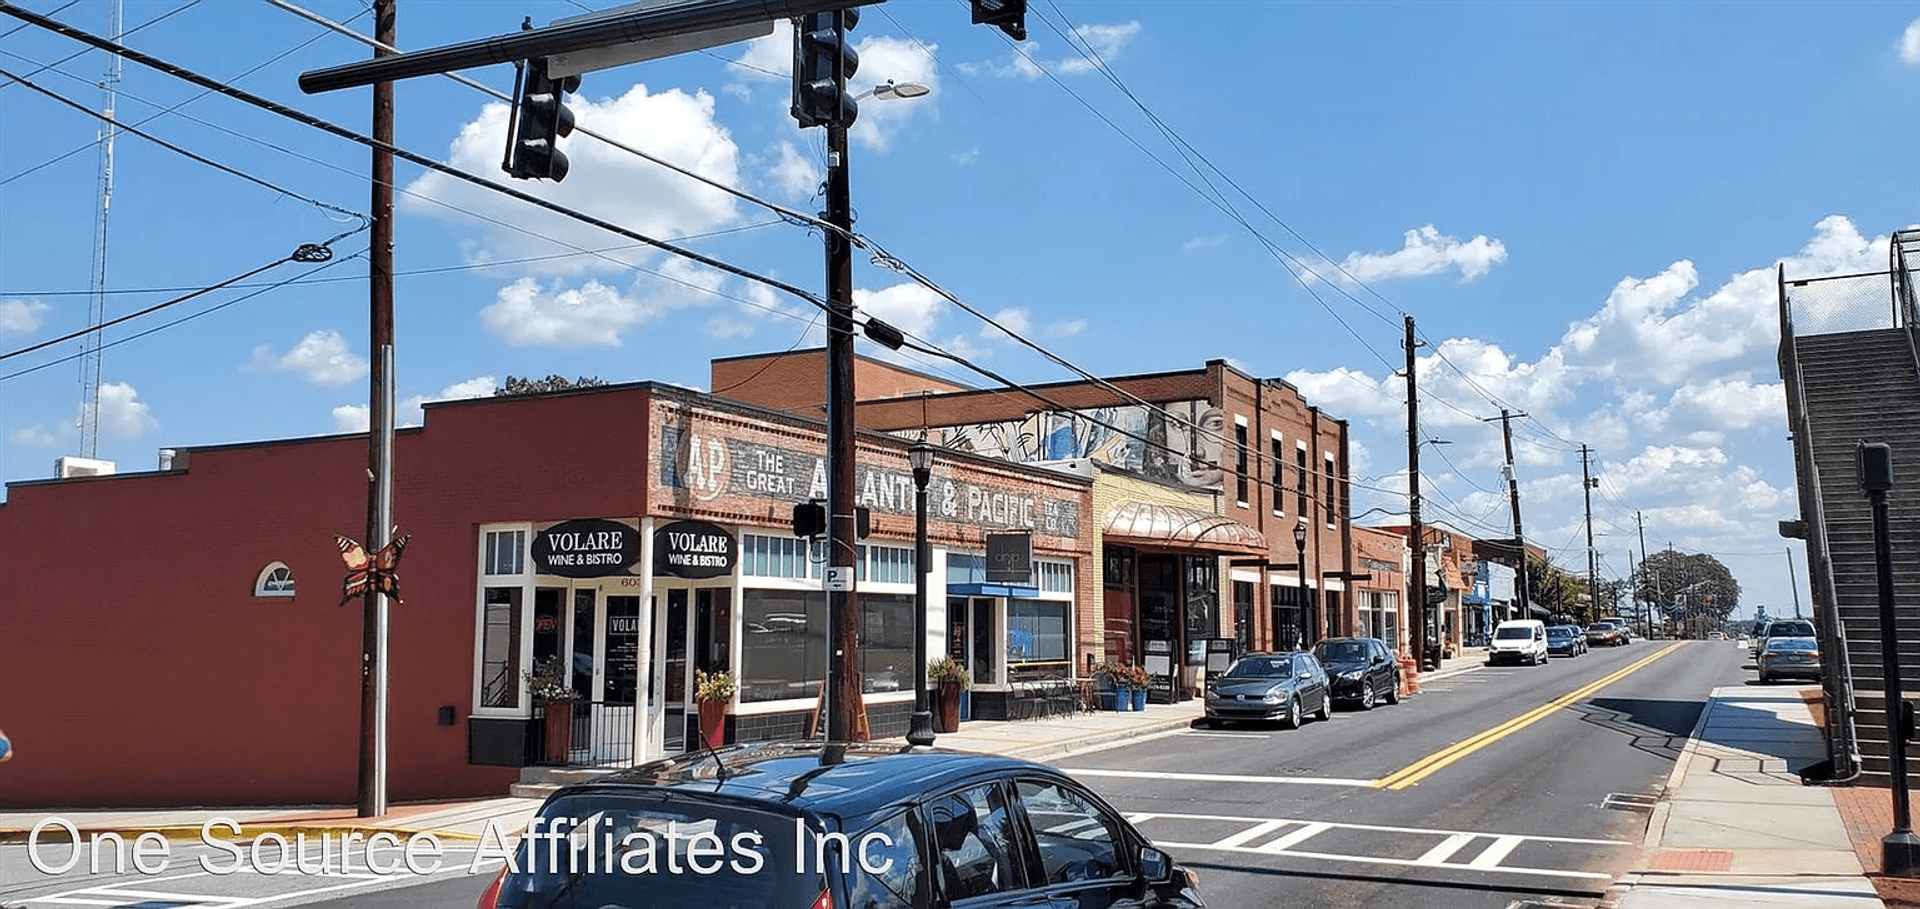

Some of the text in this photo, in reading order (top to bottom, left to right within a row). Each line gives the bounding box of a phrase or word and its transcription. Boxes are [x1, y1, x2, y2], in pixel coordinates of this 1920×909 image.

[756, 450, 784, 474] THE
[746, 471, 795, 495] GREAT
[808, 458, 929, 513] AANTI
[941, 480, 957, 517] &
[967, 486, 1035, 529] PACIFIC
[547, 531, 623, 552] VOLARE
[668, 532, 728, 554] VOLARE
[547, 552, 623, 566] WINE & BISTRO
[668, 553, 728, 567] WINE & BISTRO
